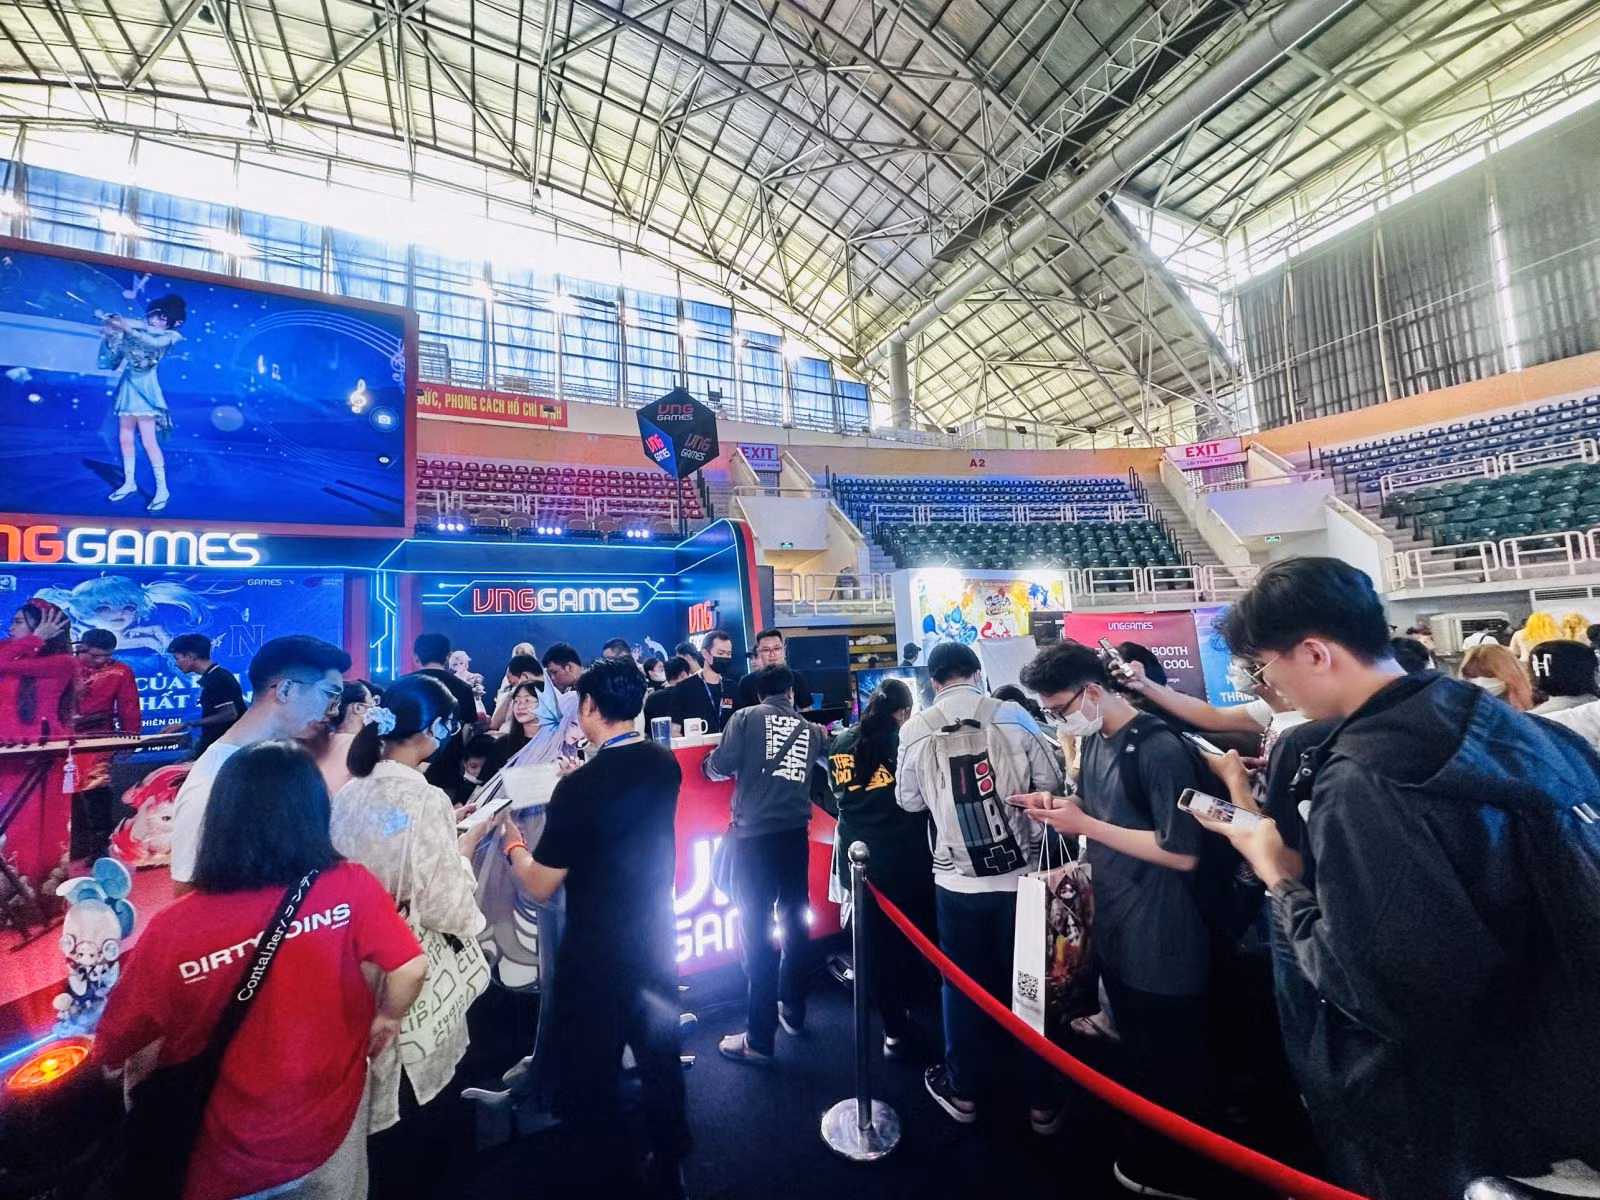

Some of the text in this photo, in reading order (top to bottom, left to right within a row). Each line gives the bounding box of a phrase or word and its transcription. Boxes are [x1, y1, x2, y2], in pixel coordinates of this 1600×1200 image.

[445, 393, 477, 411] PHONG
[480, 395, 505, 413] CÁCH
[539, 404, 562, 421] MNH
[657, 403, 694, 415] VNG
[680, 448, 706, 461] GAMES
[741, 446, 775, 459] EXIT
[1185, 443, 1220, 458] EXIT
[970, 458, 986, 467] A2
[247, 578, 282, 586] GAMES
[1108, 622, 1153, 630] VNGGAMES
[1152, 646, 1188, 656] BOOTH
[1164, 659, 1193, 669] COOL
[139, 691, 190, 710] HẤT
[141, 717, 167, 727] HIÊN
[179, 903, 351, 979] DIRTYOINS
